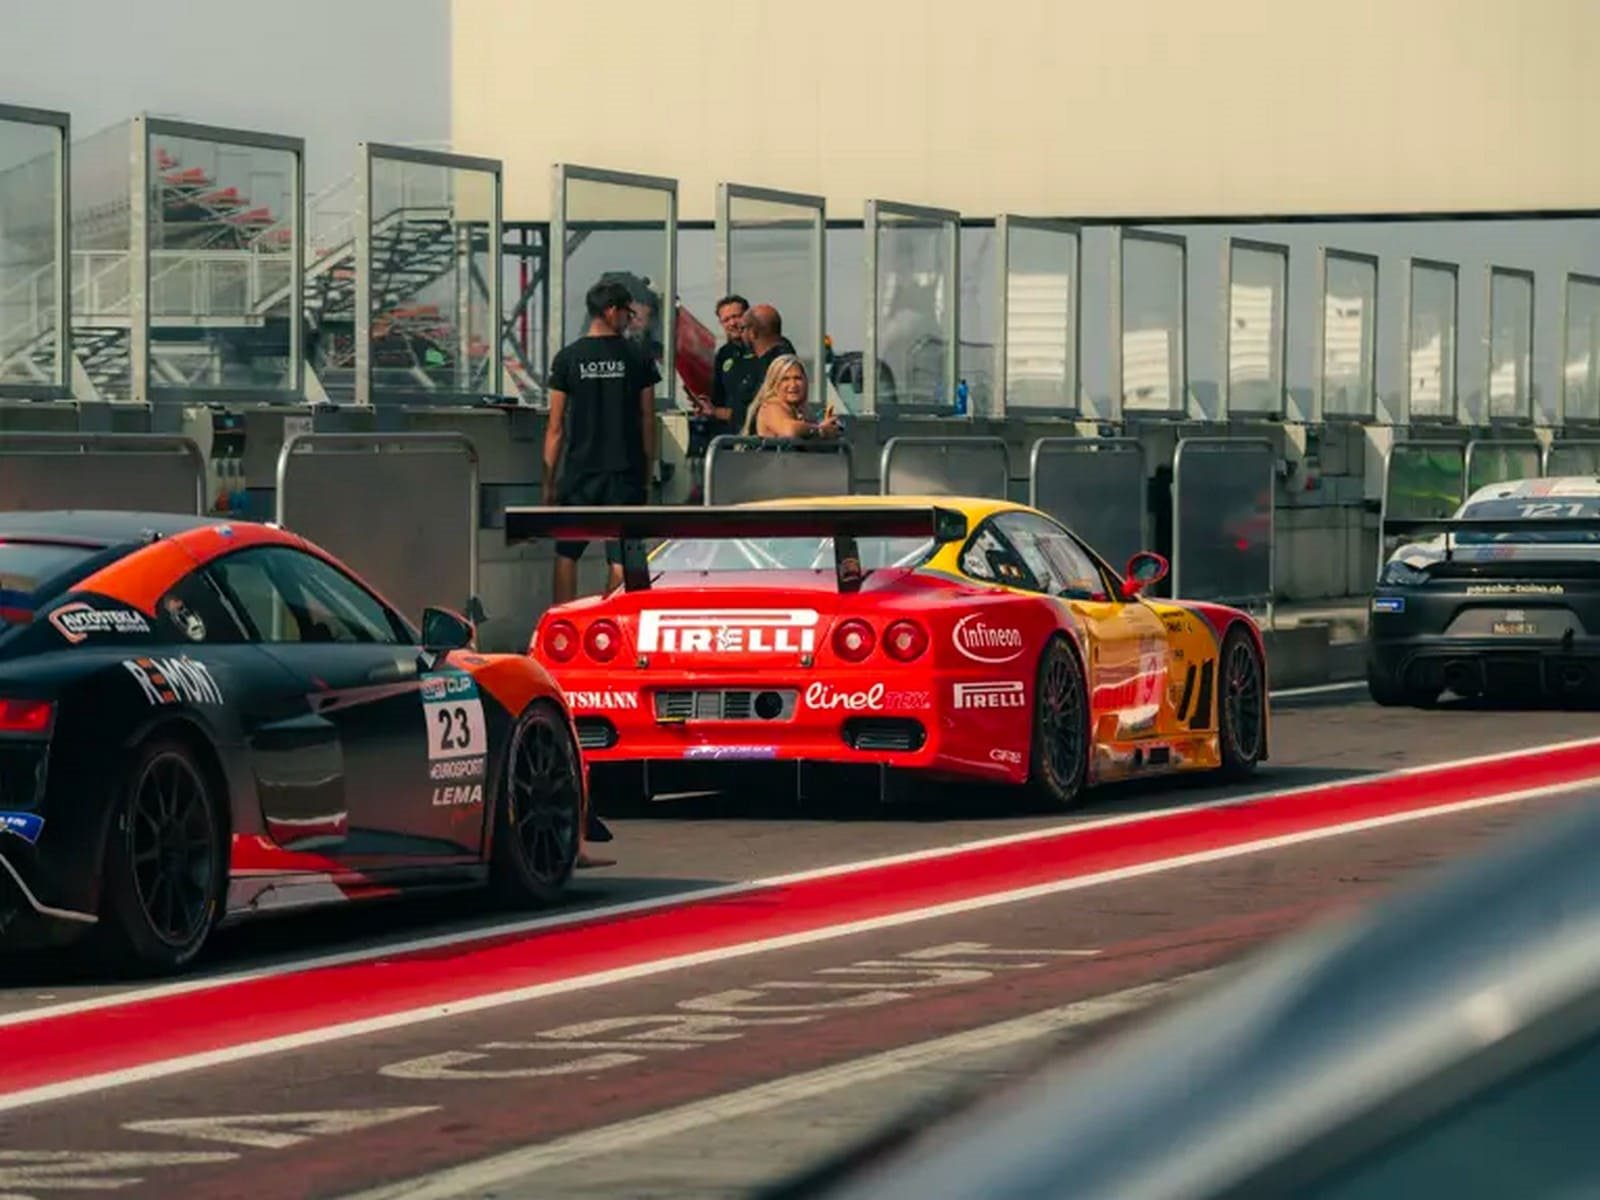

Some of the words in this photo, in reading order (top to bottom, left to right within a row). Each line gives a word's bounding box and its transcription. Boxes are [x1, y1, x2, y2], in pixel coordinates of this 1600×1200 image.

[580, 360, 624, 373] LOTUS
[1516, 503, 1584, 519] 121
[636, 609, 819, 653] PIRELLI
[961, 622, 1021, 648] Infineon
[448, 677, 471, 693] CUP
[953, 681, 1025, 709] PIRELLI
[438, 707, 471, 750] 23
[432, 785, 482, 806] LEMA
[379, 942, 1102, 1078] CIRCUIT
